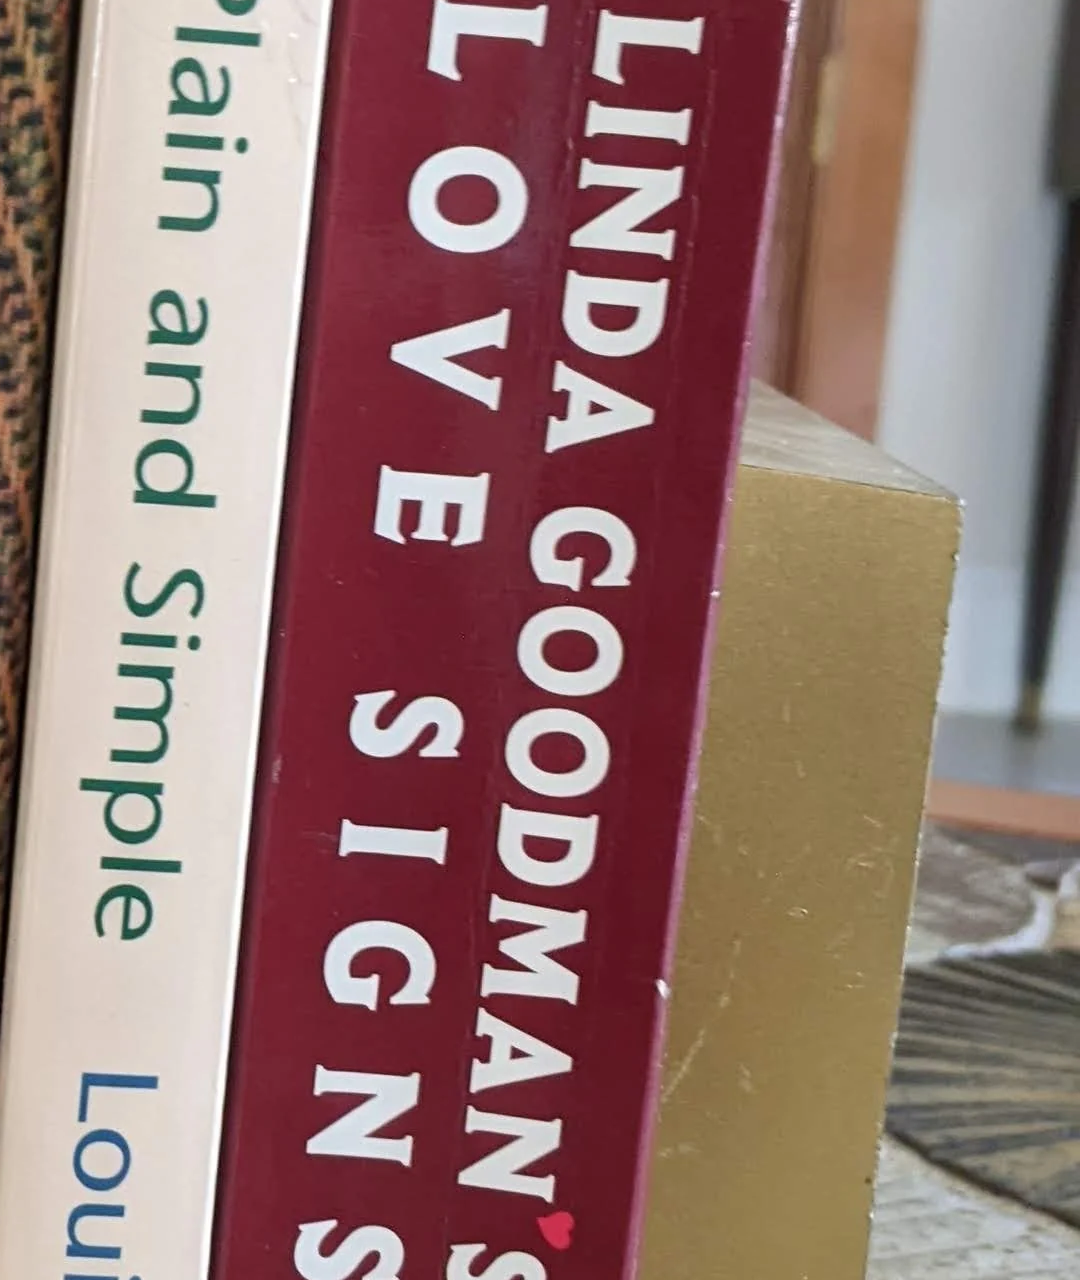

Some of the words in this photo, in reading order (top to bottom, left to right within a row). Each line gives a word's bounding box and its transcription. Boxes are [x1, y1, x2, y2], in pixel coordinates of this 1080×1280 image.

[132, 288, 218, 509] and
[544, 8, 706, 455] LINDA
[79, 560, 206, 942] Simple
